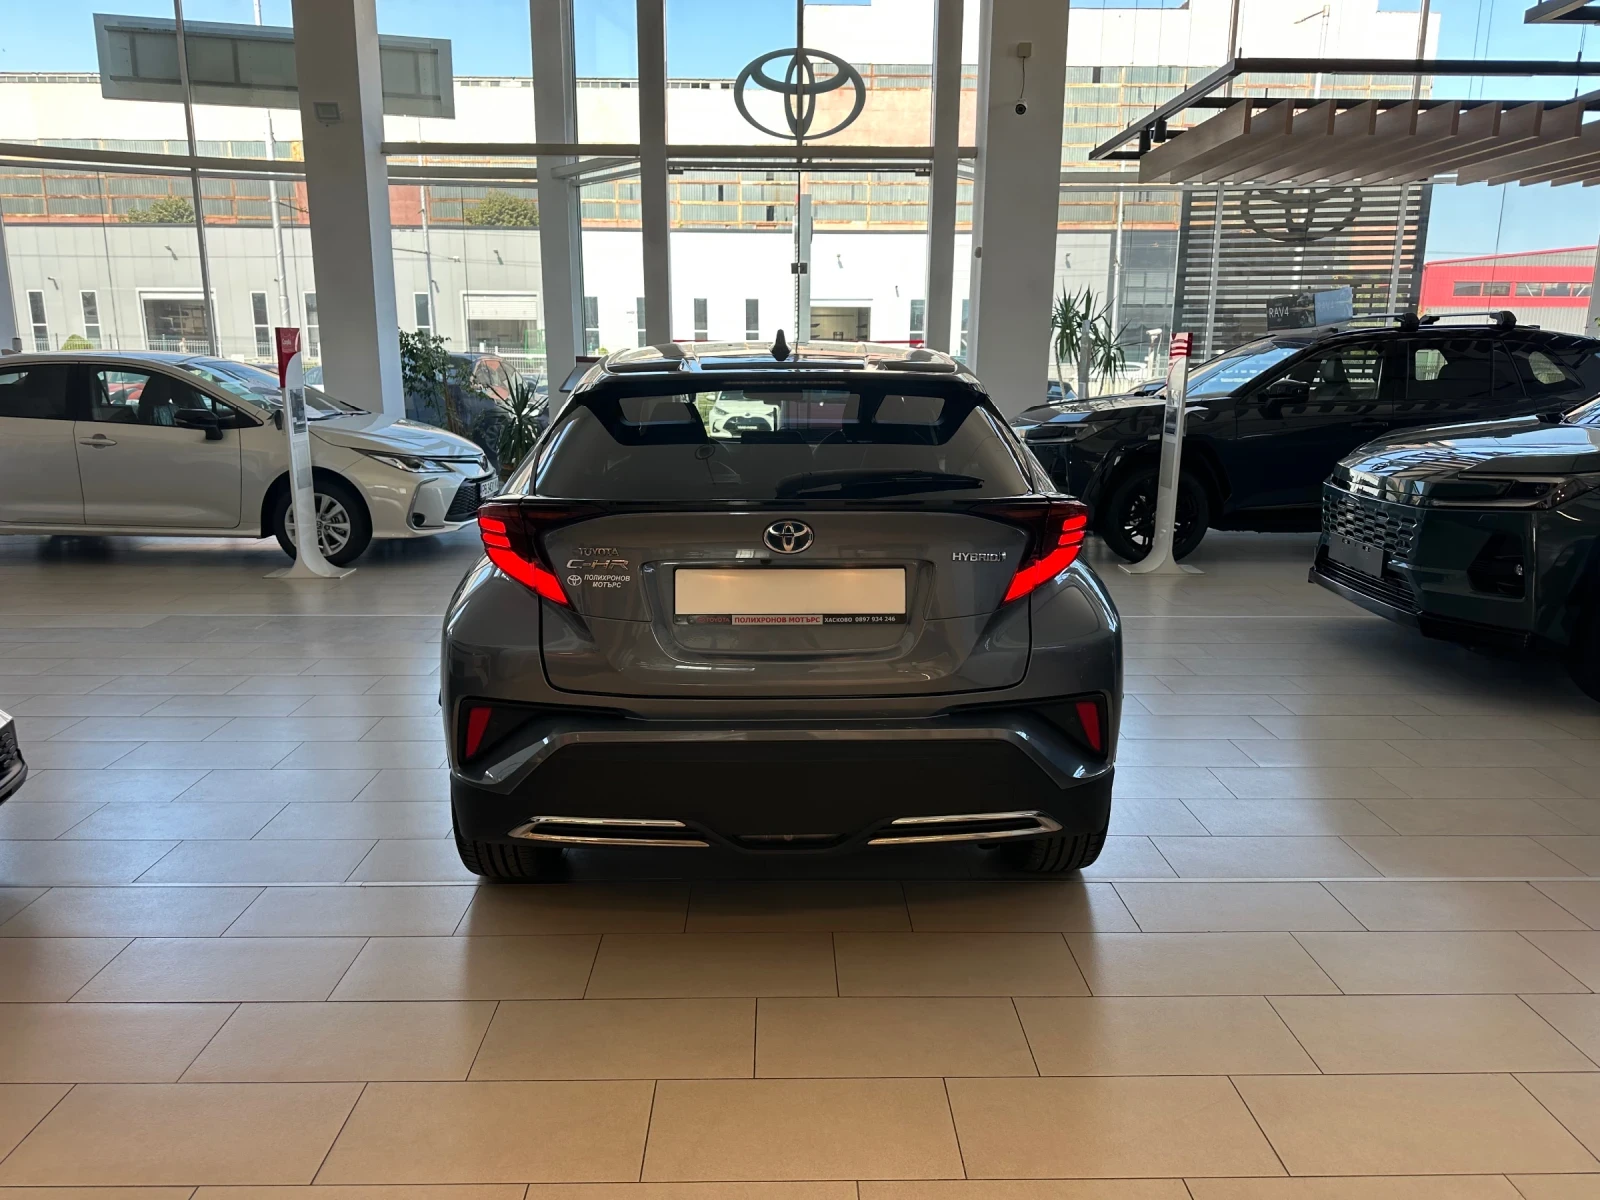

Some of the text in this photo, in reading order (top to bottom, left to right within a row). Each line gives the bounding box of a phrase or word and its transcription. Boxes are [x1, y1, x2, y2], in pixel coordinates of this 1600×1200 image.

[1269, 306, 1289, 318] RAV4
[578, 547, 620, 557] TOYOTA
[952, 551, 1000, 562] HYBRID
[566, 559, 629, 570] C-HR
[584, 574, 631, 582] ПОЛИХРОНОВ
[592, 581, 622, 589] МОТЪРС
[734, 616, 821, 624] ПОЛИХРОНОВ МОТЪРС
